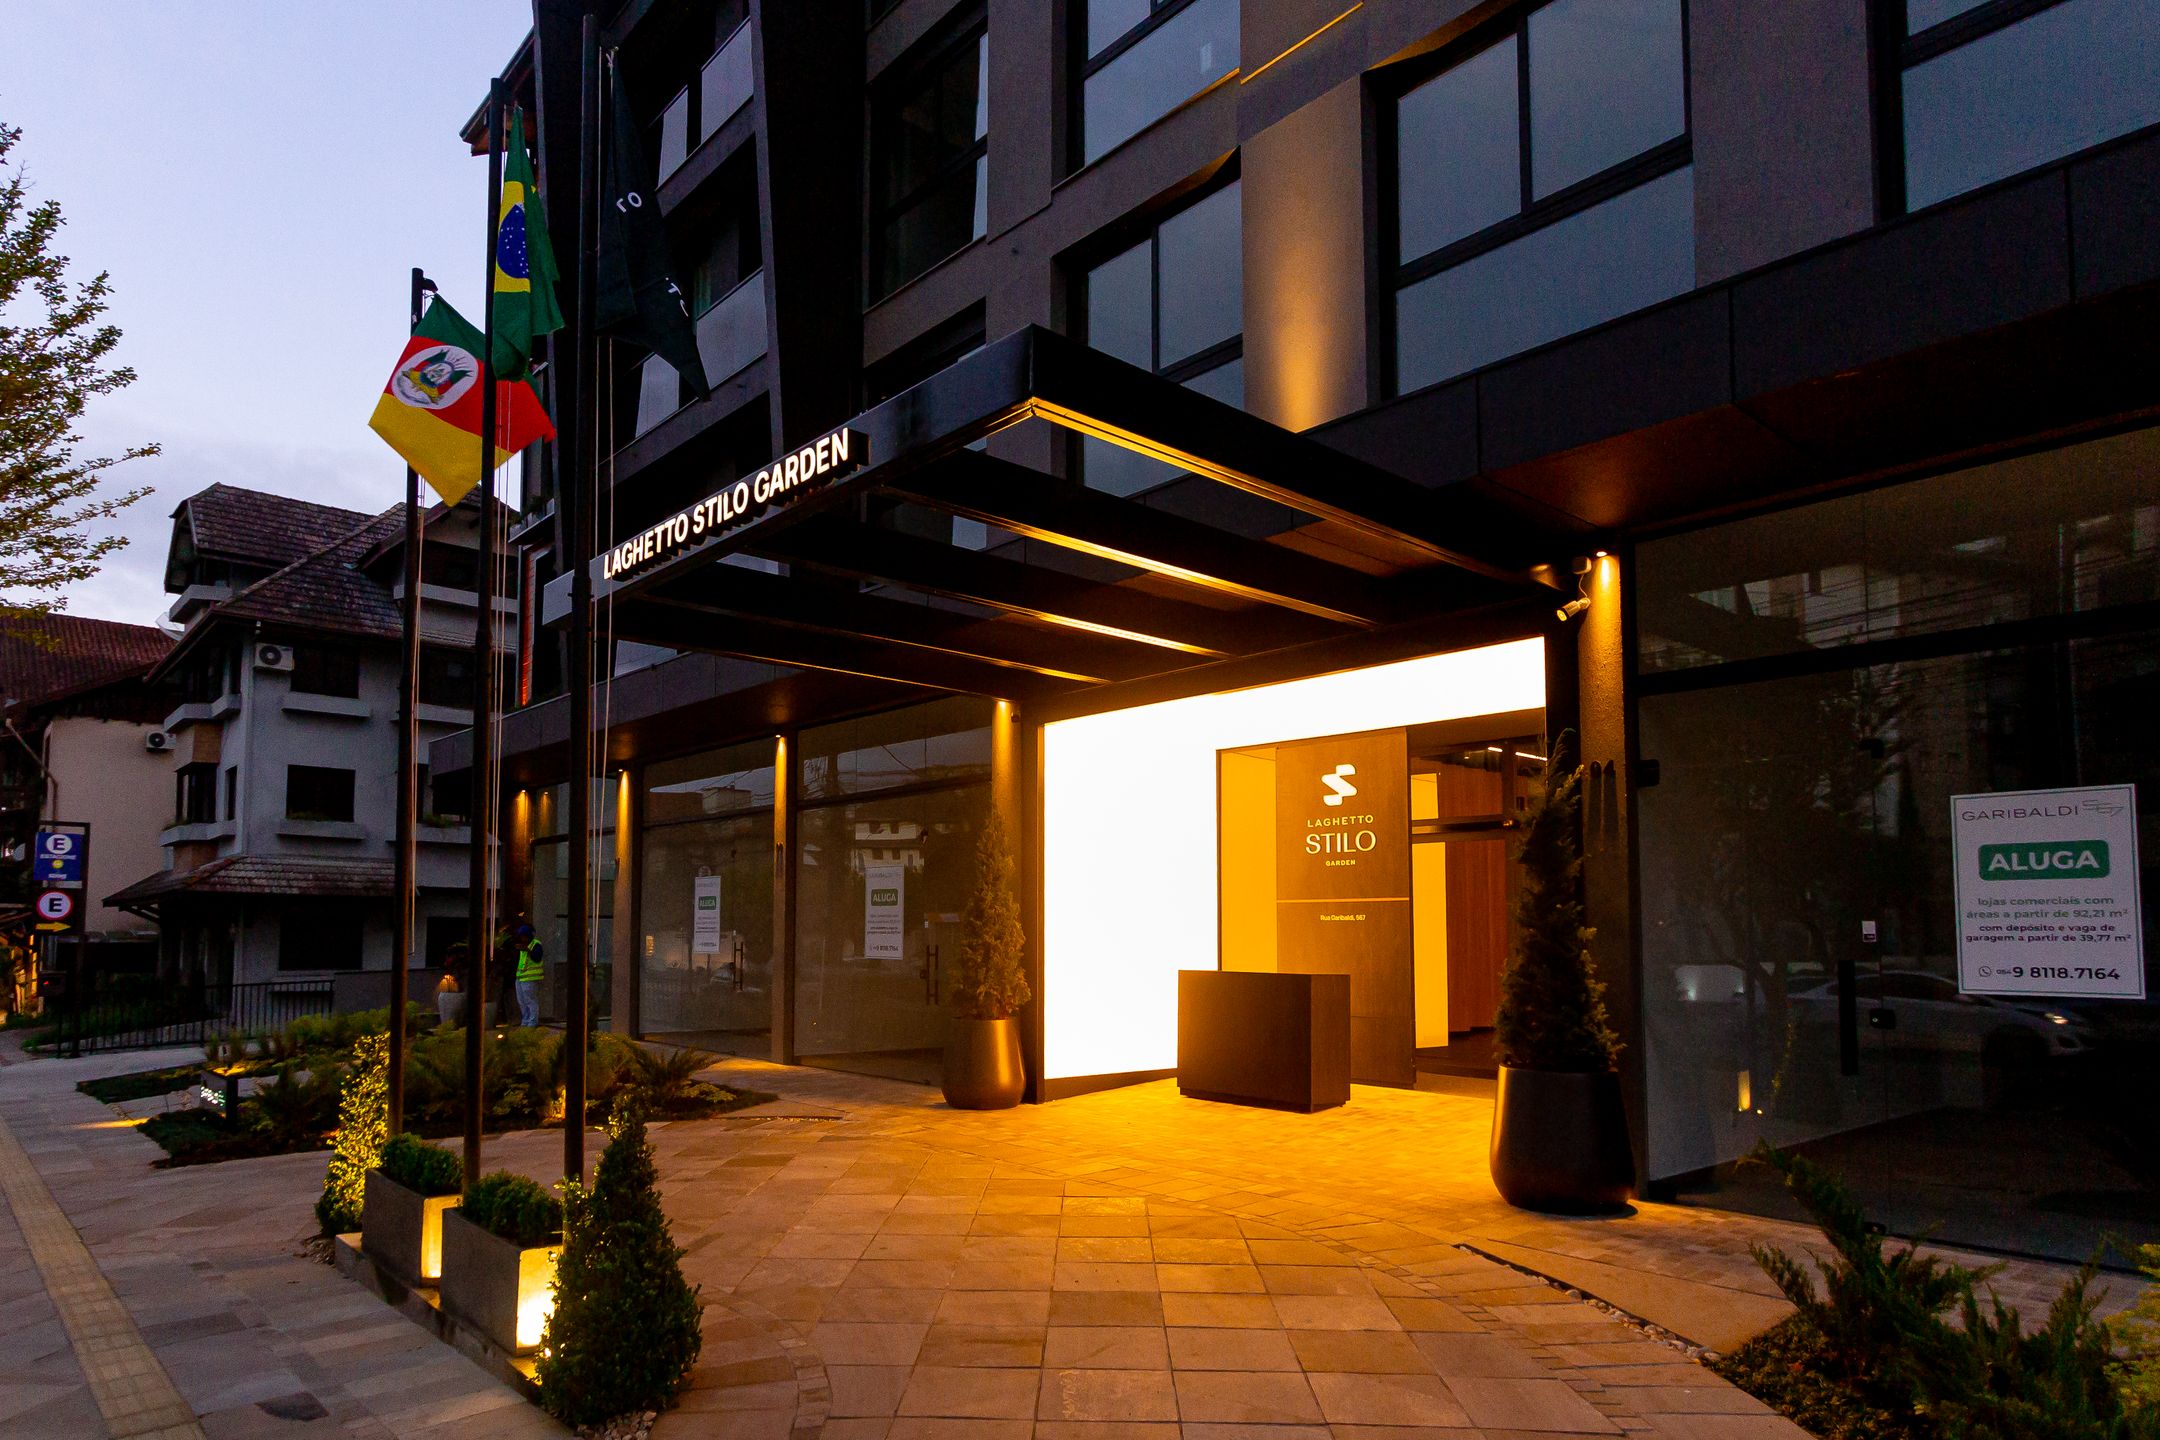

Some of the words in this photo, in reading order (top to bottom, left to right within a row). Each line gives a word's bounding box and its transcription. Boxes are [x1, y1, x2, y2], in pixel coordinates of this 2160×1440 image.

[603, 513, 689, 580] LAGHETTO
[692, 481, 750, 535] STILO
[753, 426, 850, 504] GARDEN
[1961, 805, 2079, 821] GARIBALDI
[1307, 814, 1374, 828] LAGHETTO
[53, 838, 65, 850] E
[1305, 829, 1377, 855] STILO
[1325, 859, 1356, 867] GARDEN
[1988, 850, 2100, 872] ALUGA
[873, 892, 897, 903] ALUGA
[1978, 898, 2006, 907] lojas
[2010, 896, 2080, 905] comerciais
[2084, 897, 2114, 905] com
[49, 898, 62, 912] E
[1966, 909, 1999, 919] áreas
[2014, 909, 2049, 921] partir
[2053, 909, 2069, 918] de
[2073, 909, 2105, 919] 92,21
[2006, 923, 2055, 933] depósito
[2068, 925, 2097, 933] vaga
[2100, 924, 2115, 932] de
[1966, 934, 2014, 943] garagem
[2027, 934, 2059, 943] partir
[2062, 934, 2077, 942] de
[2080, 934, 2110, 942] 39,77
[2030, 966, 2121, 980] 8118.7164
